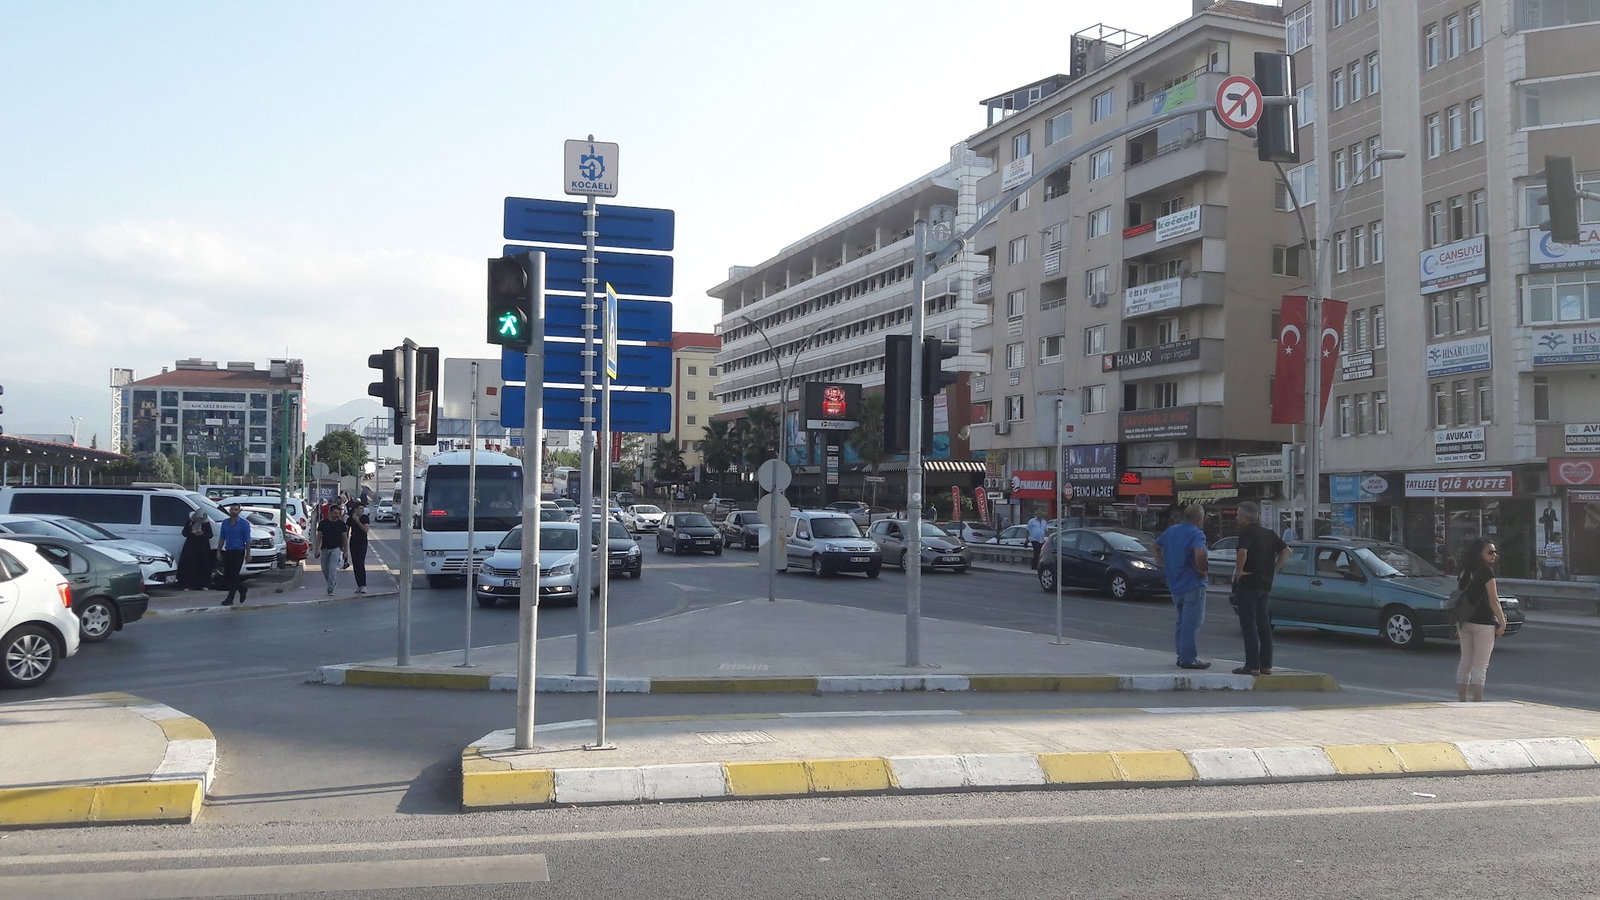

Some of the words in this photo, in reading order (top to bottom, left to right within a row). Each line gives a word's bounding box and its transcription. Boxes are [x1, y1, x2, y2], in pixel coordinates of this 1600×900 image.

[571, 181, 612, 190] KOCAELİ
[1157, 209, 1198, 229] kocaeli
[1439, 243, 1483, 262] CANSUYU
[1116, 350, 1152, 367] HANLAR
[1446, 431, 1473, 441] AVUKAT
[1019, 480, 1053, 490] PAMUKKALE
[1073, 486, 1090, 497] TEKNO
[1091, 485, 1114, 497] MARKET
[1441, 477, 1462, 492] ÇİĞ
[1466, 476, 1506, 489] KÖFTE
